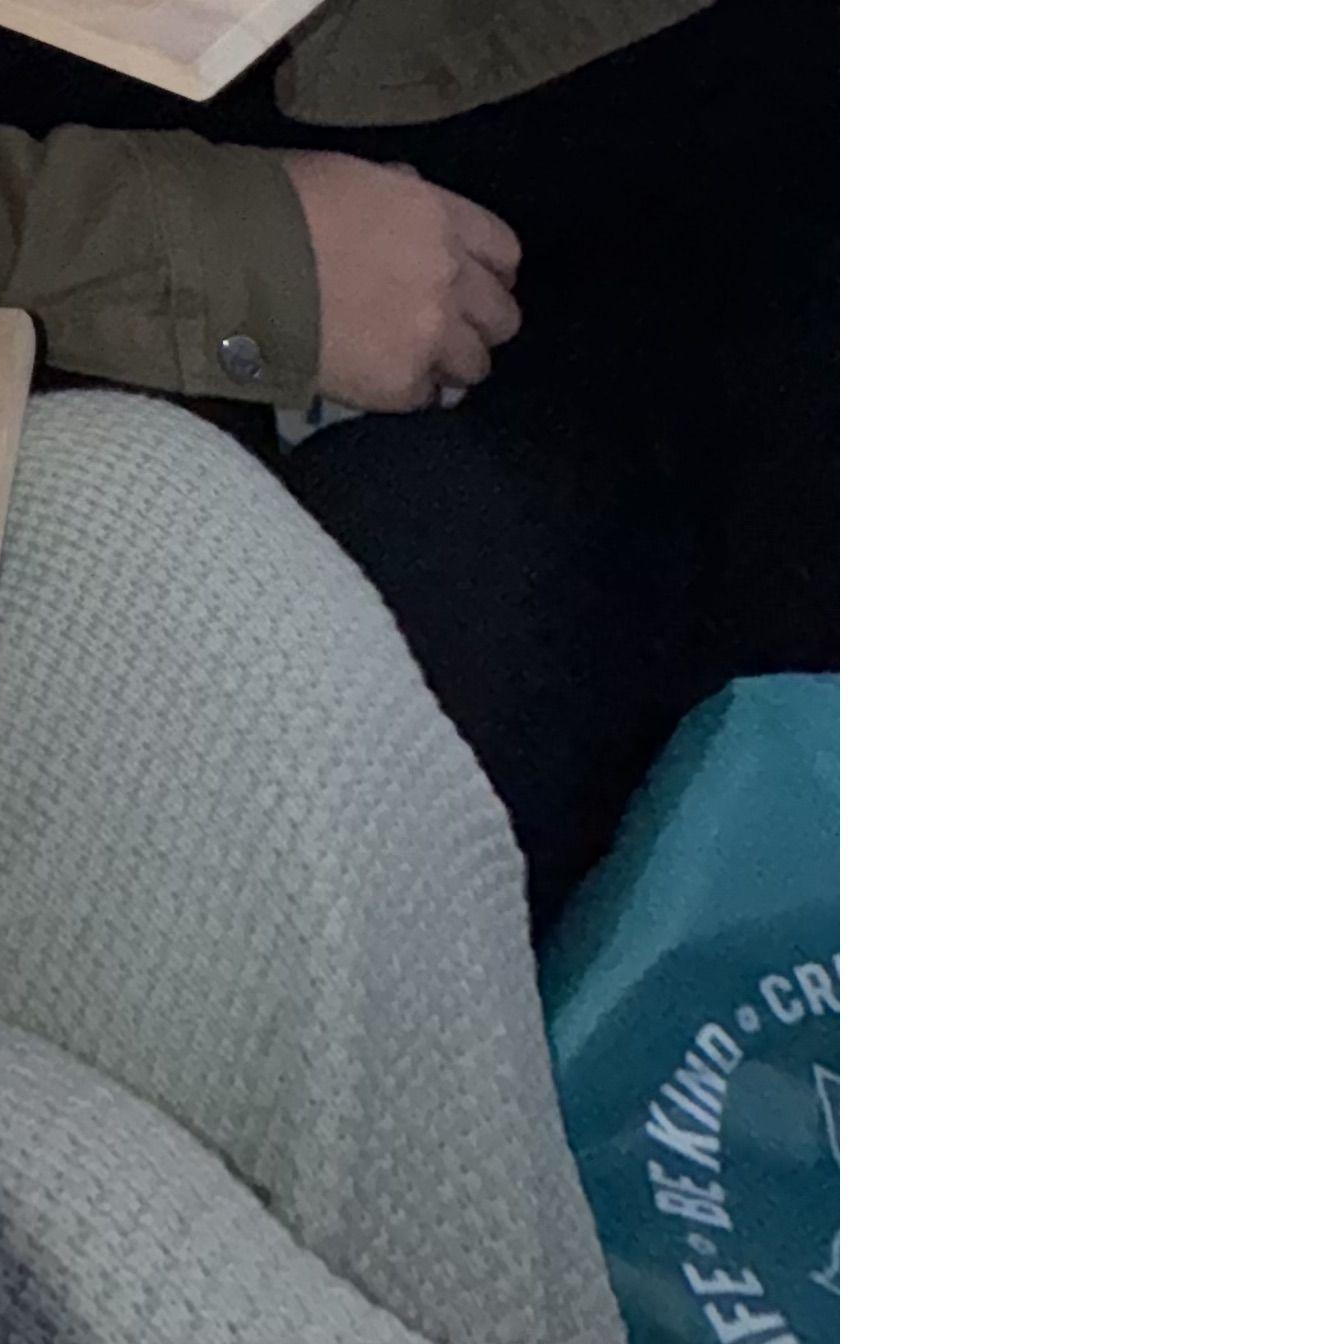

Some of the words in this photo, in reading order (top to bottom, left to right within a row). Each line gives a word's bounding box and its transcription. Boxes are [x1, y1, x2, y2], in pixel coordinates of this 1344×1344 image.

[759, 952, 840, 1024] CR
[645, 1021, 744, 1174] KIND
[647, 1159, 733, 1231] BE
[680, 1262, 801, 1344] FE
